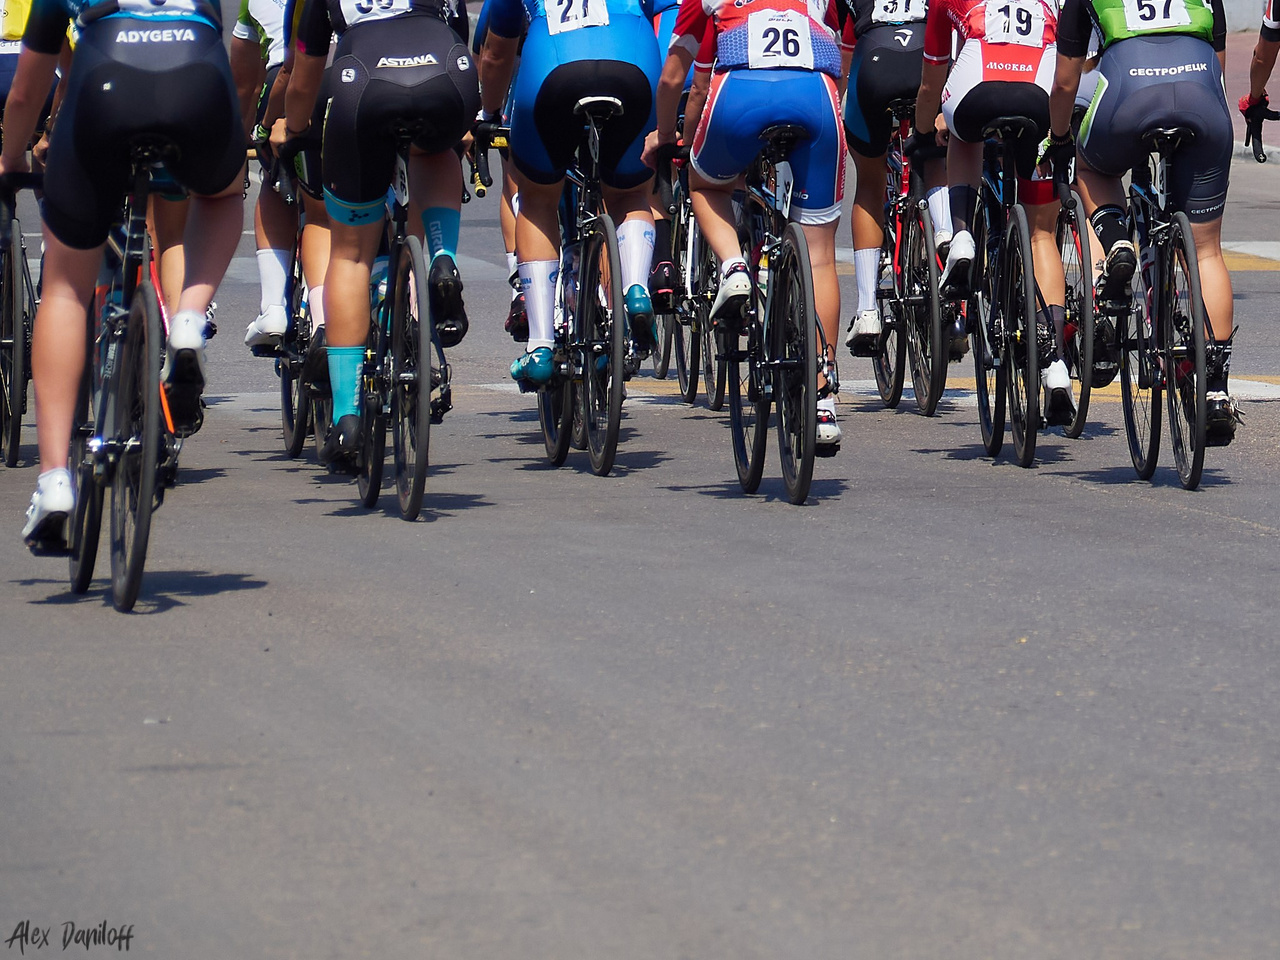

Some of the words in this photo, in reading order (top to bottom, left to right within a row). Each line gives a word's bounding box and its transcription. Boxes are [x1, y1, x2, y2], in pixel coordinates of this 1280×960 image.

[998, 4, 1032, 36] 19
[116, 28, 195, 43] ADYGEYA
[762, 27, 801, 57] 26
[376, 53, 438, 68] ASTANA
[986, 61, 1035, 72] МОСКВА
[1129, 62, 1208, 76] СЕСТРОРЕЦК
